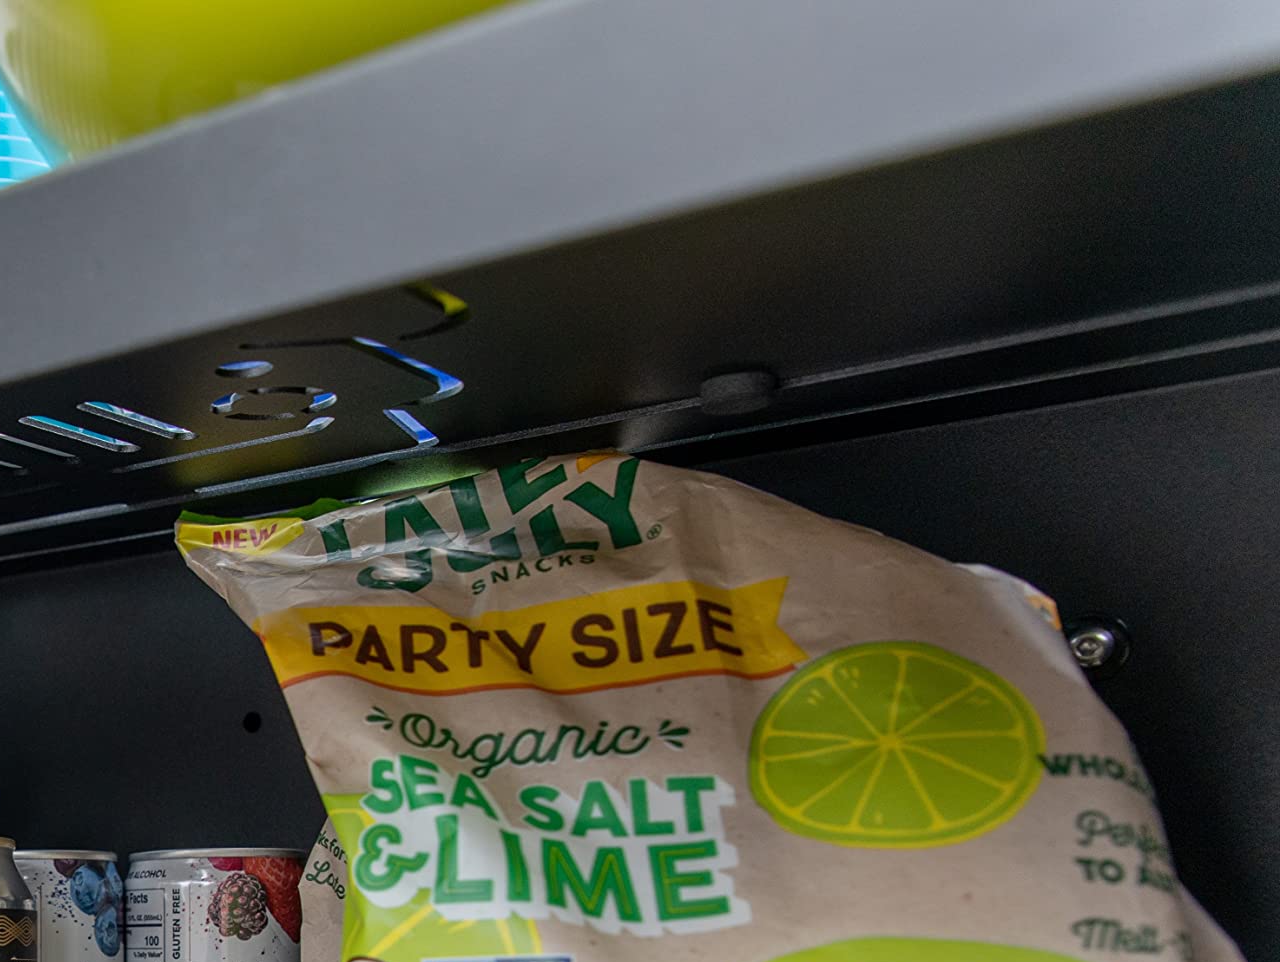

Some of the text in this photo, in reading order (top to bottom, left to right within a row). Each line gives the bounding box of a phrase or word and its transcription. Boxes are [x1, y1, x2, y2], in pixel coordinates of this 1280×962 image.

[472, 553, 596, 596] SNACKS
[310, 599, 744, 674] PARTY SIZE
[400, 712, 650, 778] Organic
[368, 755, 717, 838] SEA SALT
[129, 893, 149, 904] Facts
[172, 888, 181, 914] FREE
[144, 936, 160, 946] 100
[172, 919, 181, 959] GLUTEN
